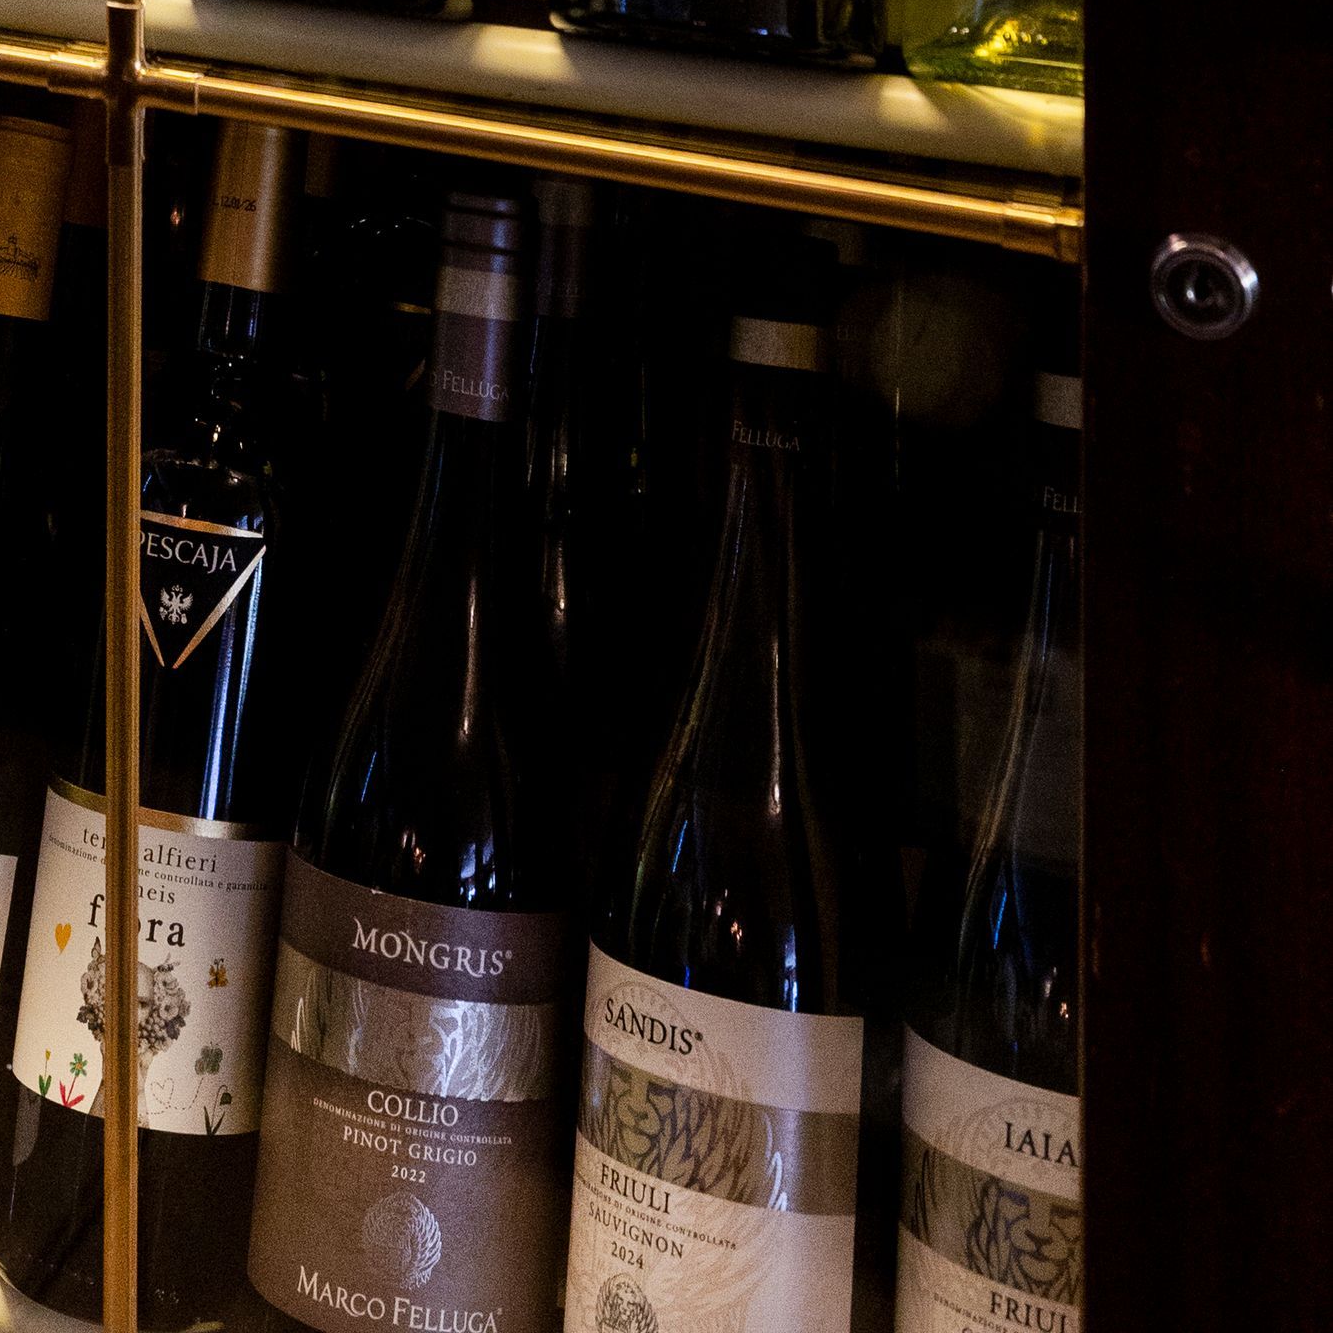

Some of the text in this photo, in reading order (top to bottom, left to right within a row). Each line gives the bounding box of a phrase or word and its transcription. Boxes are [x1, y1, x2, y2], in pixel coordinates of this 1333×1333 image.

[731, 419, 802, 453] FELLUGA
[143, 843, 218, 874] alfieri
[154, 869, 214, 889] controllata
[351, 917, 505, 979] MONGRIS
[604, 996, 694, 1057] SANDIS
[312, 1096, 513, 1146] DENOMINAZIONE DI ORIGINE CONTROLLATA
[367, 1089, 460, 1128] COLLIO
[342, 1125, 478, 1168] PINOT GRIGIO
[391, 1164, 427, 1185] 2022
[600, 1162, 672, 1216] FRIULI
[588, 1201, 685, 1260] SAUVIGNON
[610, 1240, 646, 1271] 2024
[296, 1264, 498, 1333] MARCO FELLUGA
